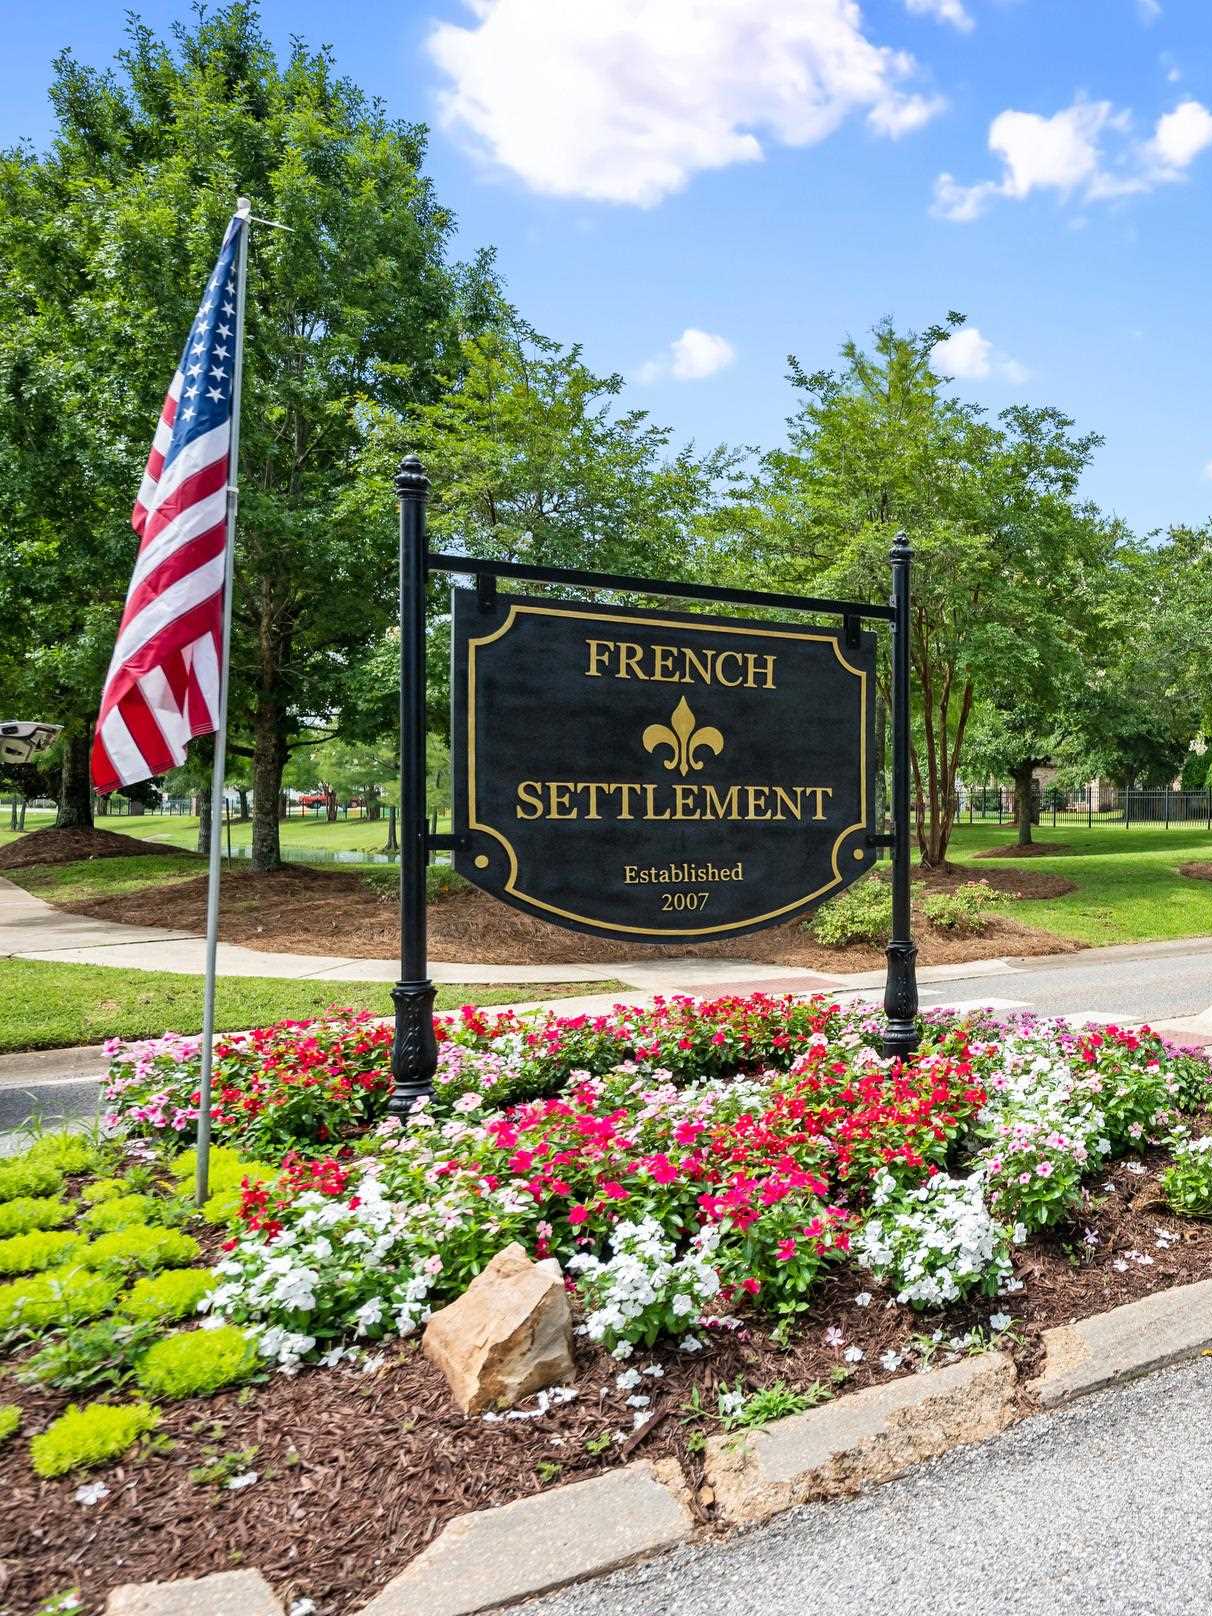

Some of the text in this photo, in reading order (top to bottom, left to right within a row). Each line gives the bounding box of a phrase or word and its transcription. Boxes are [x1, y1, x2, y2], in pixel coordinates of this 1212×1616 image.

[585, 639, 777, 689] FRENCH
[516, 780, 833, 821] SETTLEMENT
[624, 863, 744, 884] Established
[661, 893, 709, 912] 2007
